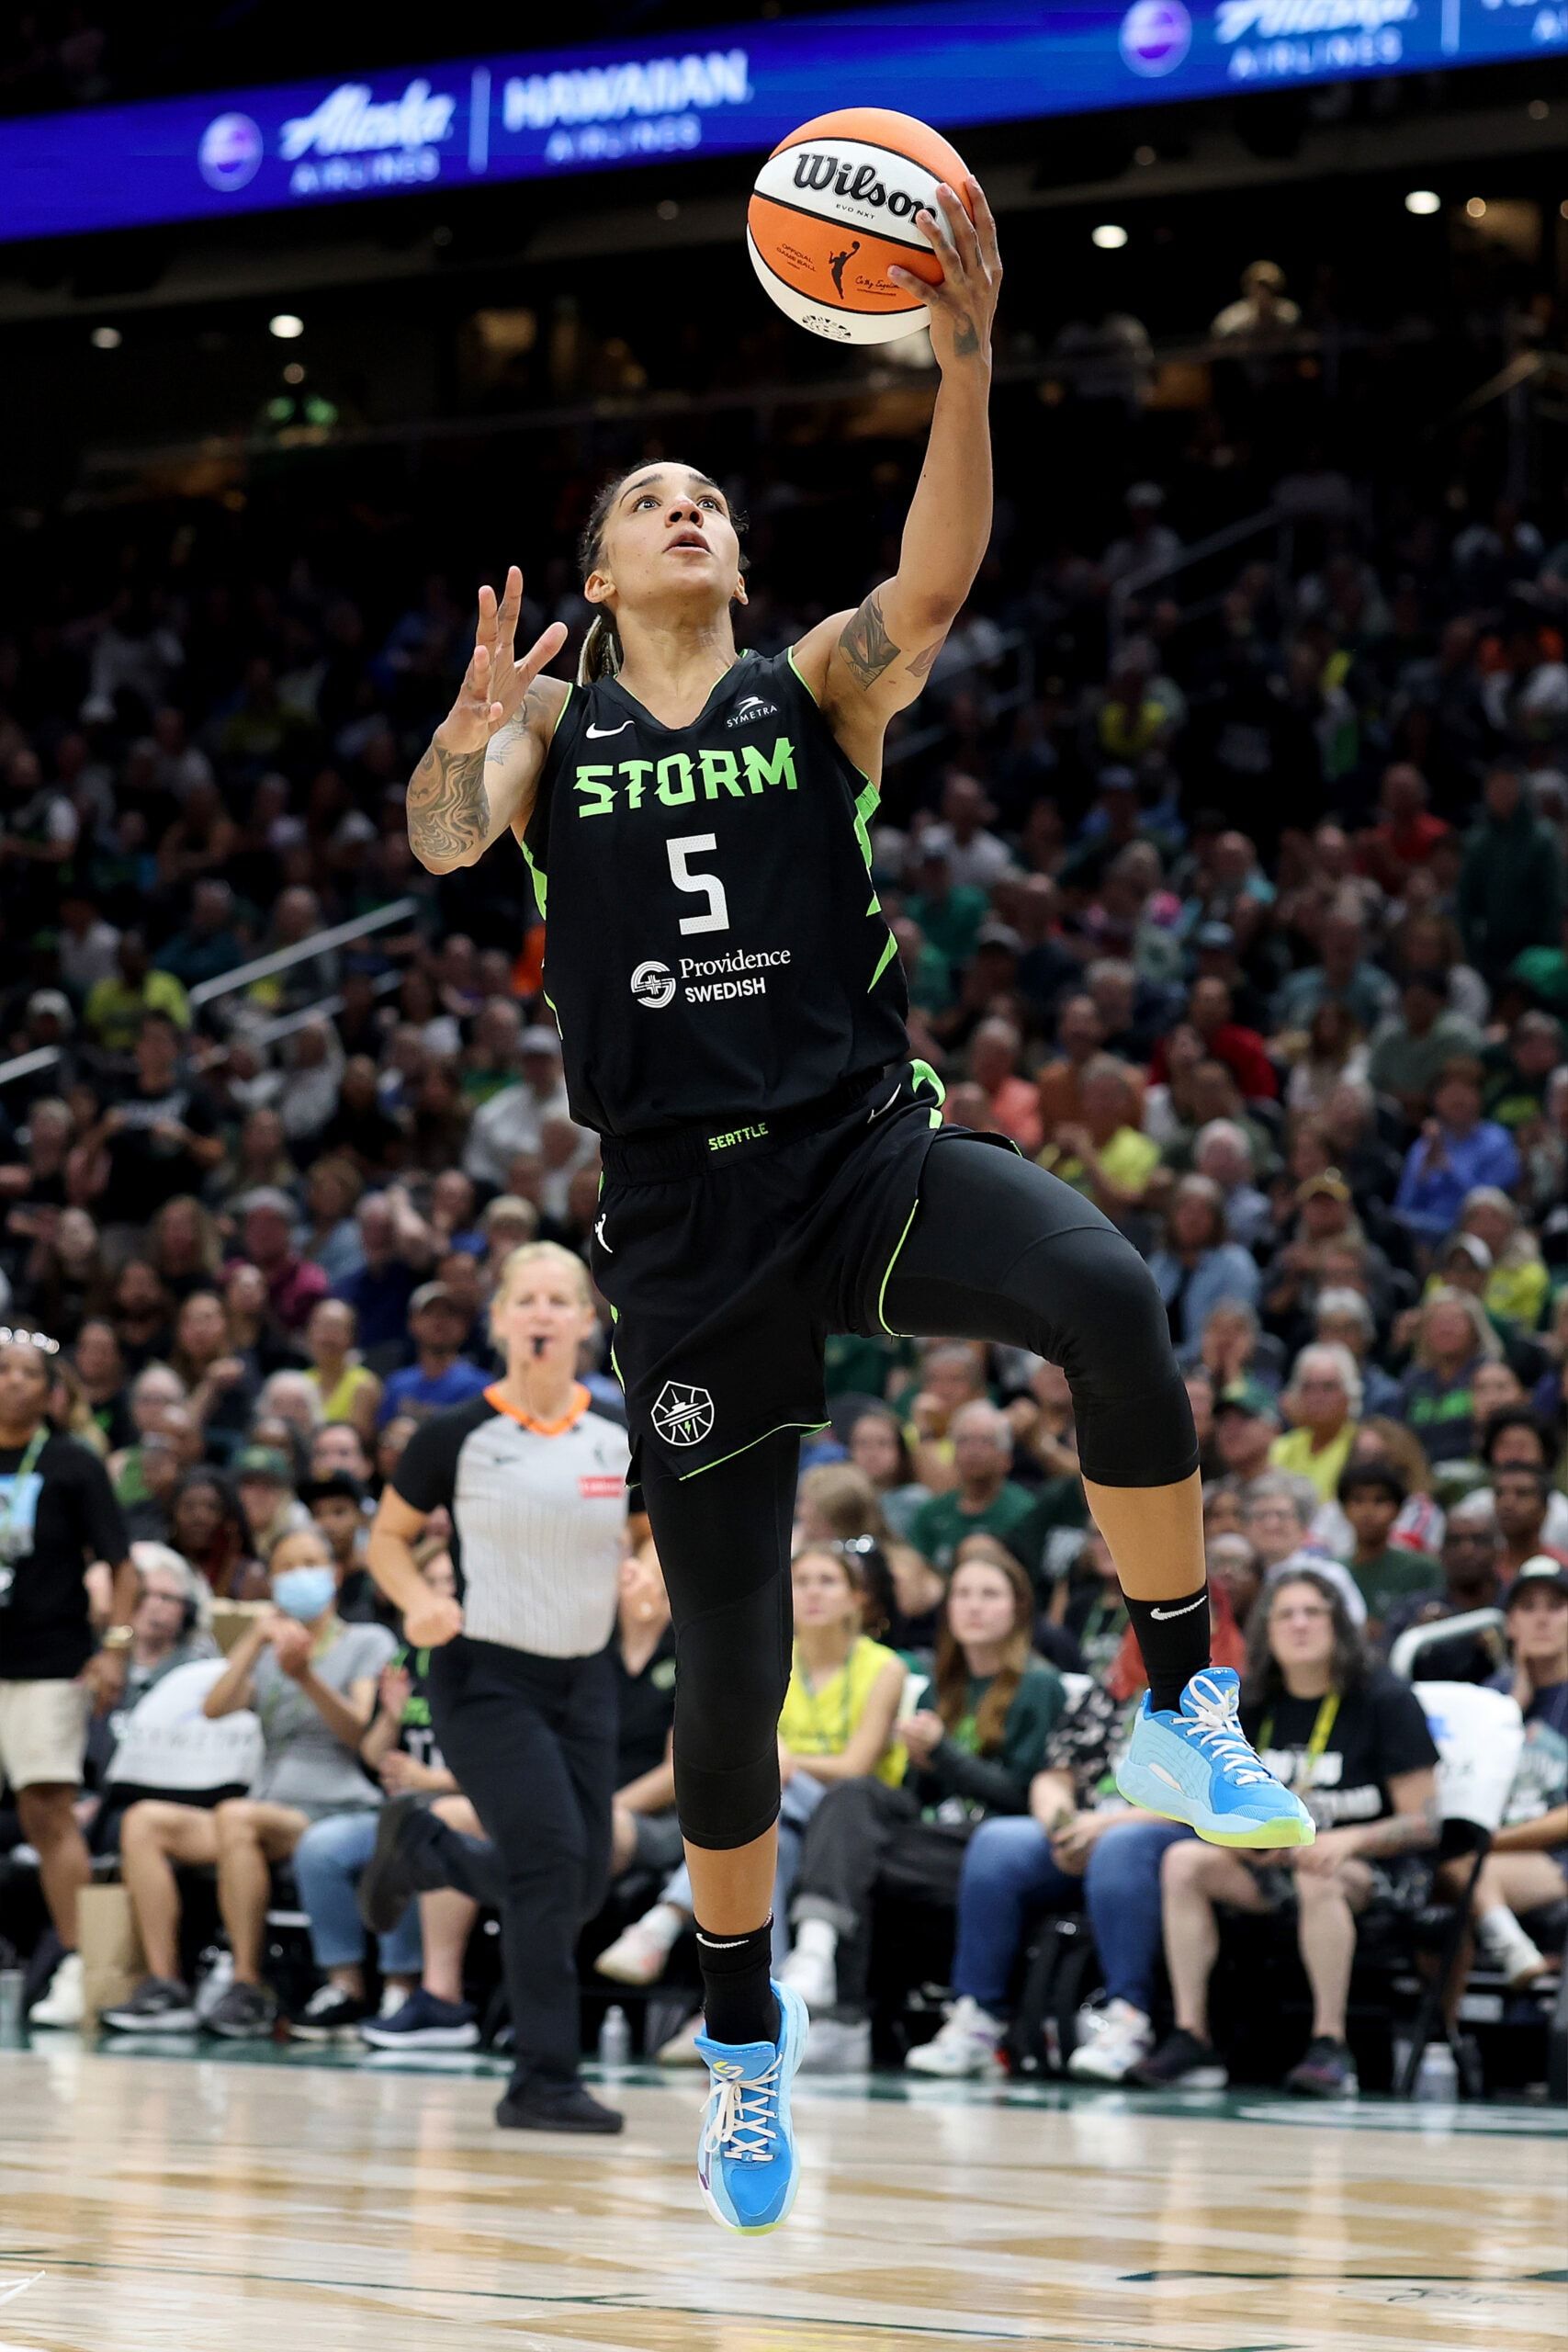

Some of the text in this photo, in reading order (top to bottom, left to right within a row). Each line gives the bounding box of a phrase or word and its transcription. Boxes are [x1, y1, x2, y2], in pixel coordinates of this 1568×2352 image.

[279, 49, 749, 161] Alaska HAWAIIAN
[794, 153, 937, 224] Wilson
[836, 203, 875, 220] EVO NXT
[726, 704, 778, 728] SYMETRA
[573, 737, 798, 818] STORM
[666, 832, 730, 935] 5
[679, 949, 791, 978] Providence
[684, 977, 766, 1003] SWEDISH
[707, 1122, 769, 1151] SEATTLE
